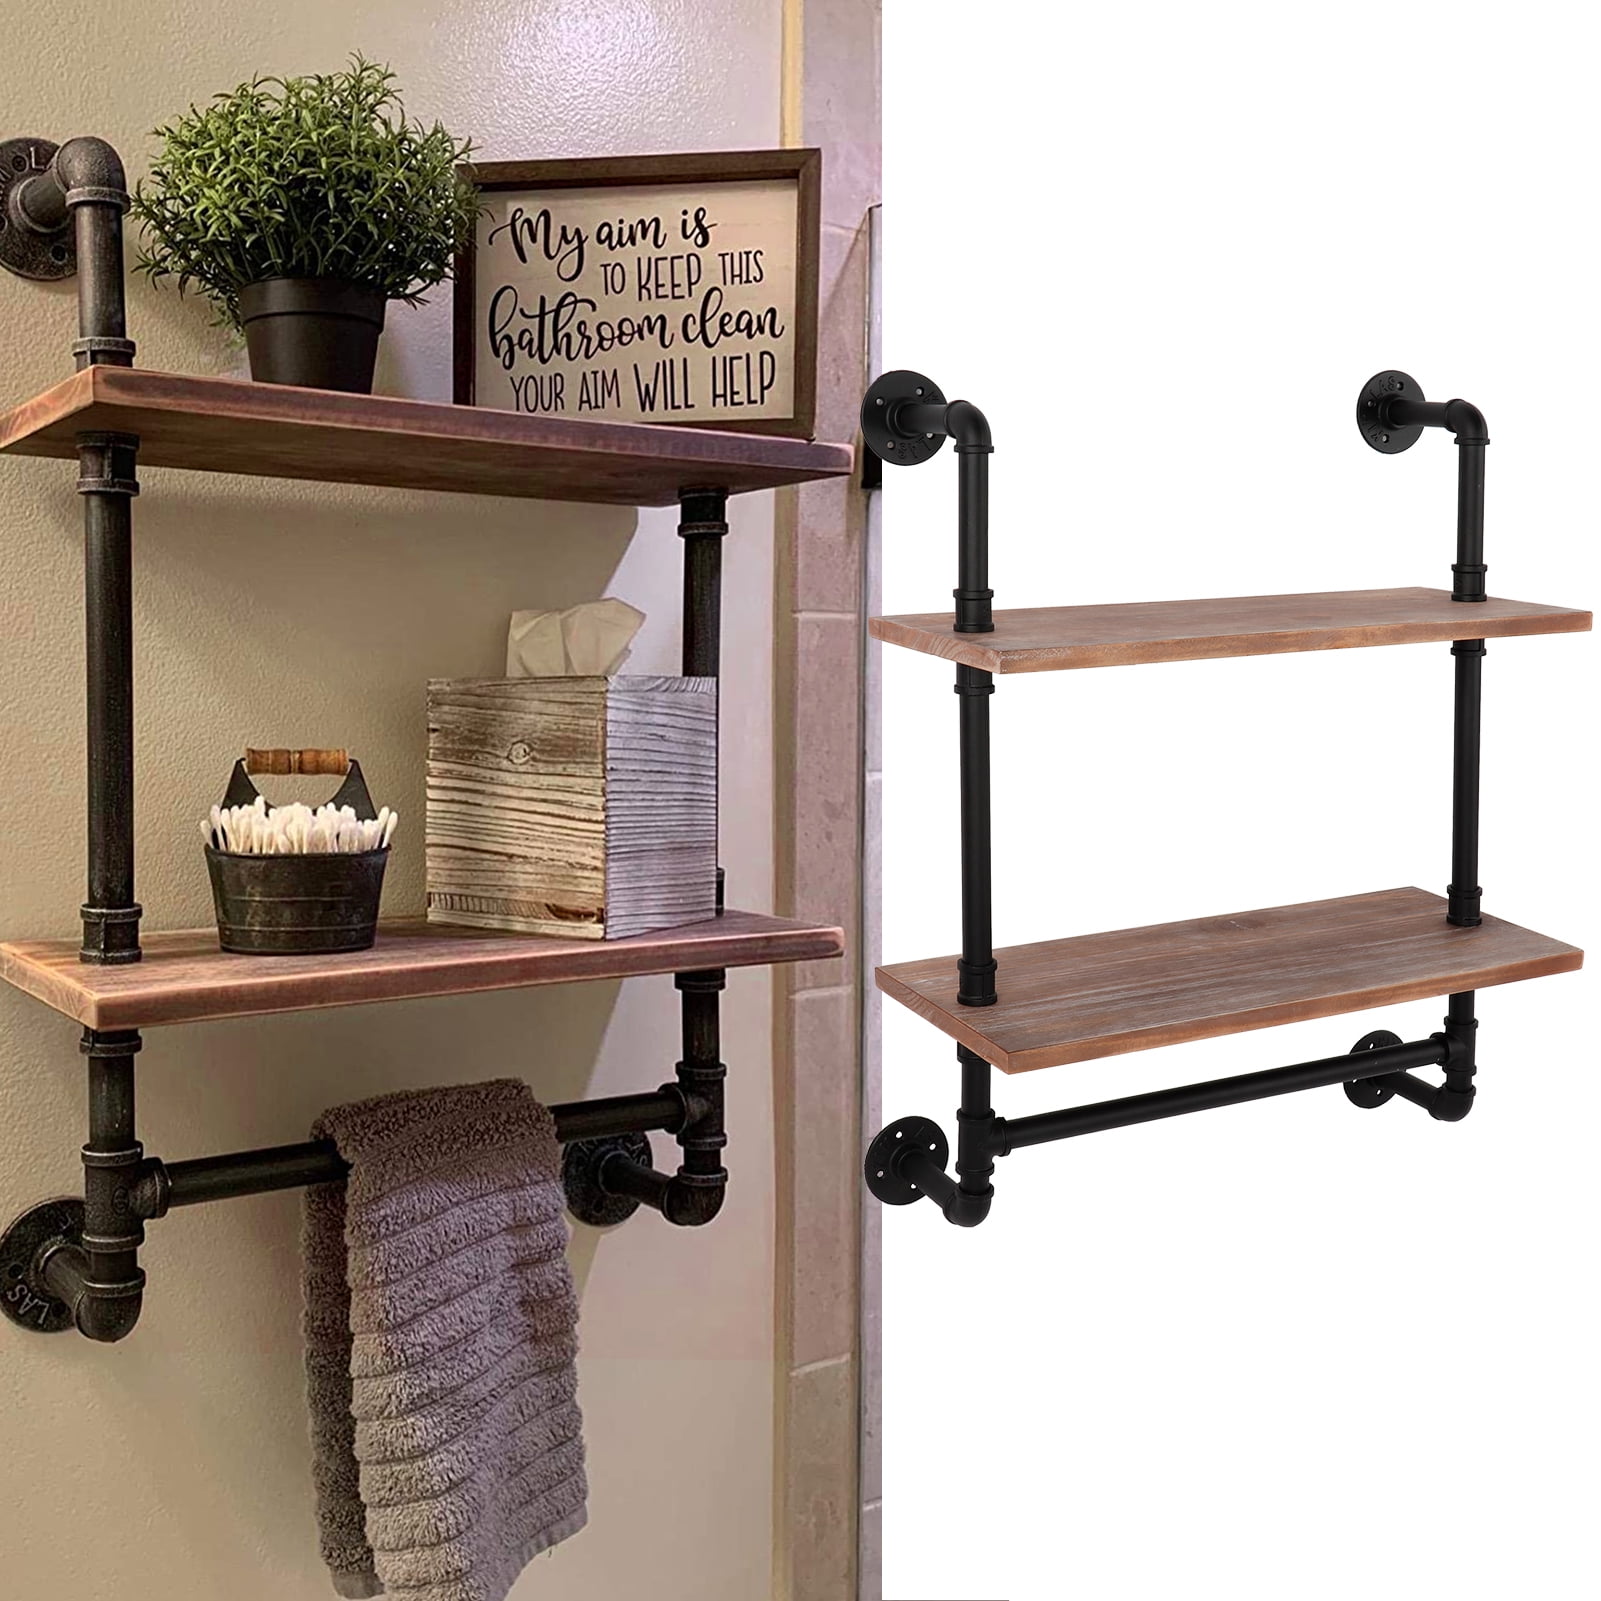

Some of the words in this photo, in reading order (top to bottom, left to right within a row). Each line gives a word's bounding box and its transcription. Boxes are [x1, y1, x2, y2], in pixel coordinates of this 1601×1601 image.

[488, 207, 588, 282] My
[596, 217, 666, 251] aim
[681, 206, 718, 249] is
[600, 261, 626, 295] TO
[637, 253, 701, 301] KEEP
[718, 250, 764, 286] THIS
[488, 285, 674, 371] bathroom
[681, 287, 785, 349] clean
[509, 372, 565, 413] YOUR
[578, 368, 621, 411] AIM
[633, 357, 696, 412] WILL
[711, 350, 776, 408] HELP
